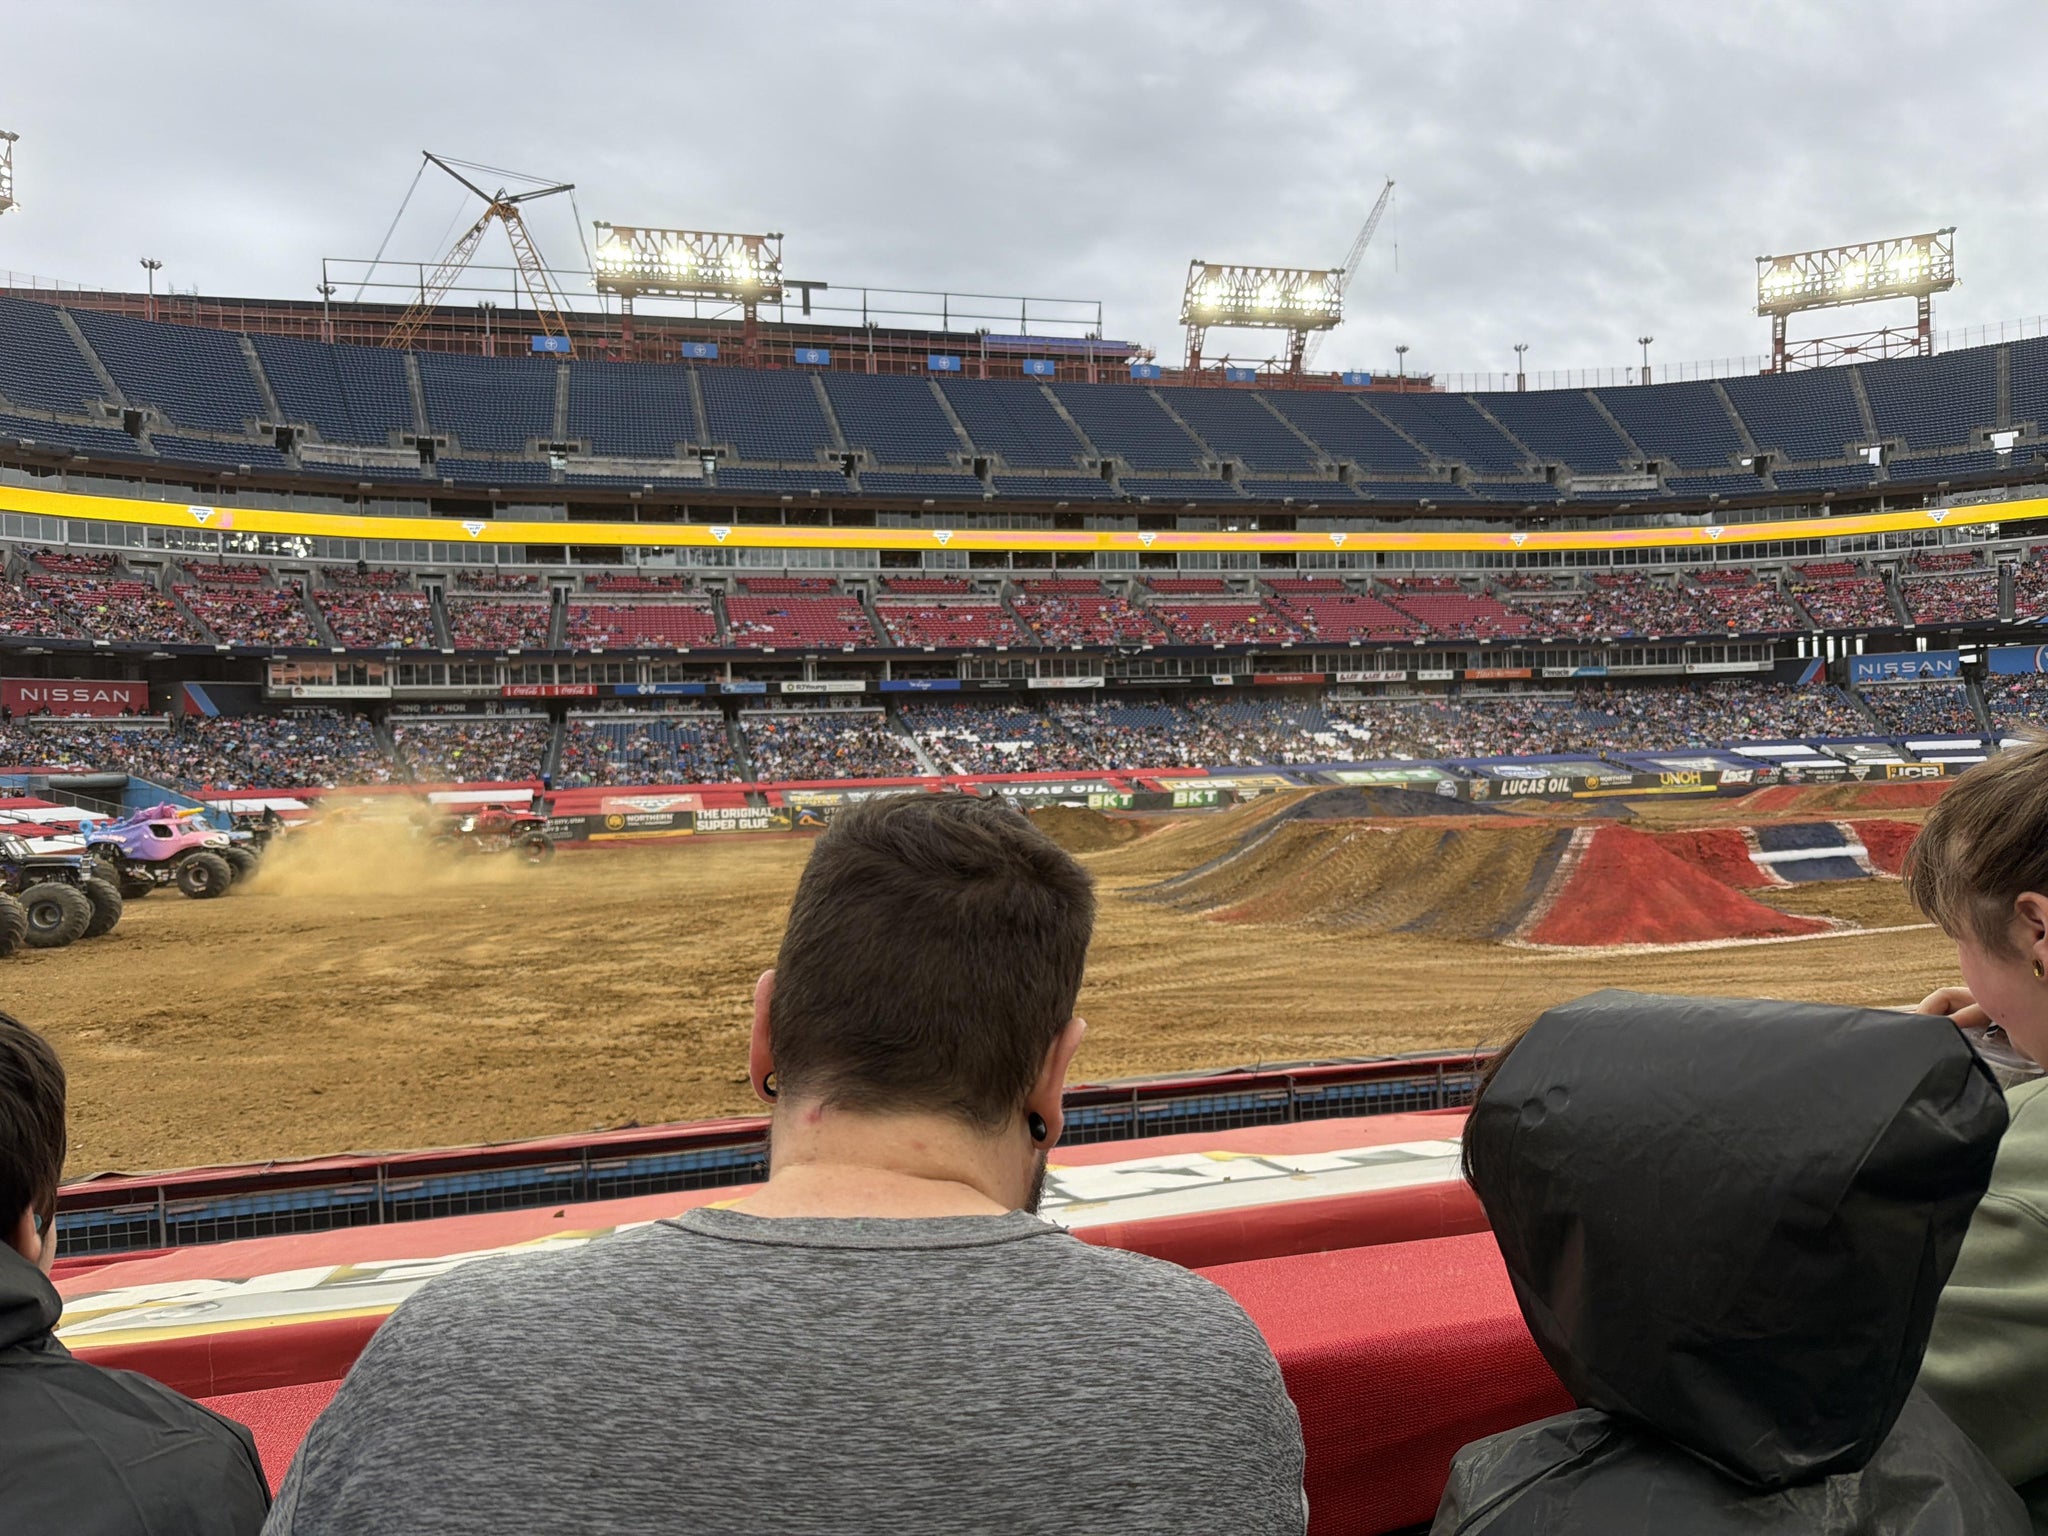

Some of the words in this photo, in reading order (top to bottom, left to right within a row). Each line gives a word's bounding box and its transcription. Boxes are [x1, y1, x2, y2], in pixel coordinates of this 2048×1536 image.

[1858, 660, 1952, 675] NISSAN
[20, 688, 130, 702] NISSAN
[513, 687, 539, 695] Coca-Cola
[561, 686, 585, 694] Coca-Cola
[430, 704, 466, 712] HNOR
[1659, 771, 1701, 785] UNOH
[1892, 766, 1940, 778] JCB
[1070, 785, 1109, 793] OIL
[1500, 778, 1545, 795] LUCAS
[1548, 777, 1571, 793] OIL
[1089, 794, 1133, 808] BKT
[1174, 791, 1218, 805] BKT
[626, 814, 673, 822] NORTHERN
[696, 809, 719, 820] THE
[720, 807, 774, 819] ORIGINAL
[696, 820, 738, 831] SUPER
[739, 818, 769, 830] GLUE
